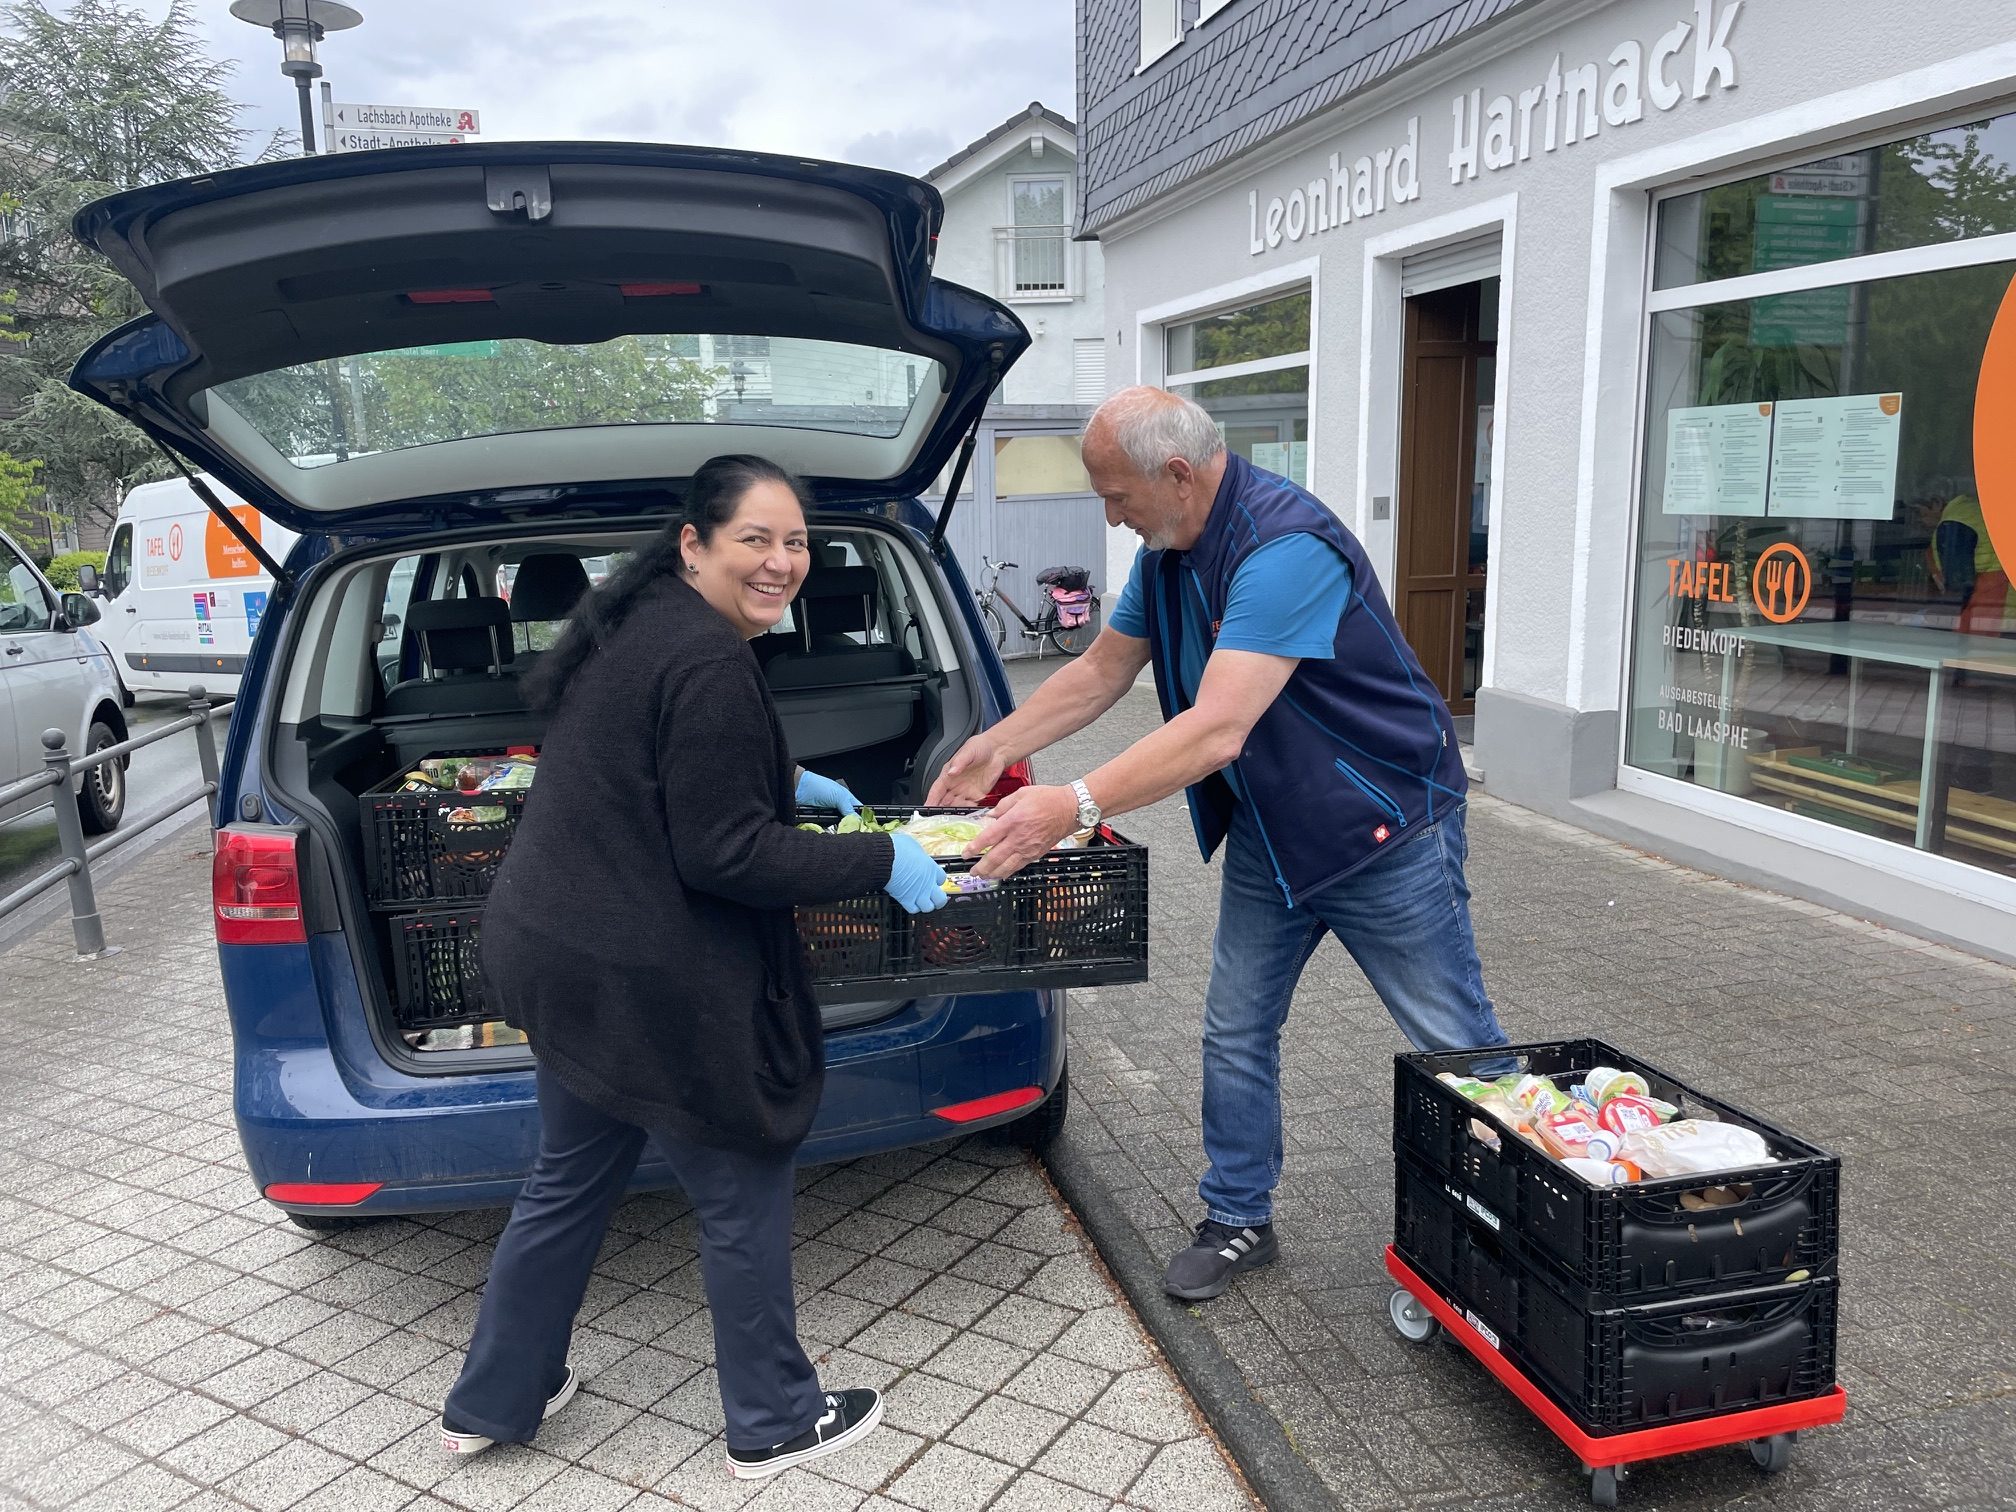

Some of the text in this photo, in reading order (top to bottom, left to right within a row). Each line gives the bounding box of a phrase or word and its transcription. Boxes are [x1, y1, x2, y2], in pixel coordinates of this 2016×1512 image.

[357, 108, 407, 125] Lachsbach
[409, 111, 452, 129] Apotheke
[1248, 0, 1745, 255] Leonhard Hartnack
[146, 537, 165, 557] TAFEL
[1666, 559, 1734, 603] TAFEL
[1663, 624, 1747, 658] BIEDENKOPF
[1659, 684, 1732, 712] AUSGABESTELLE:
[1658, 708, 1750, 750] BAD LAASPHE
